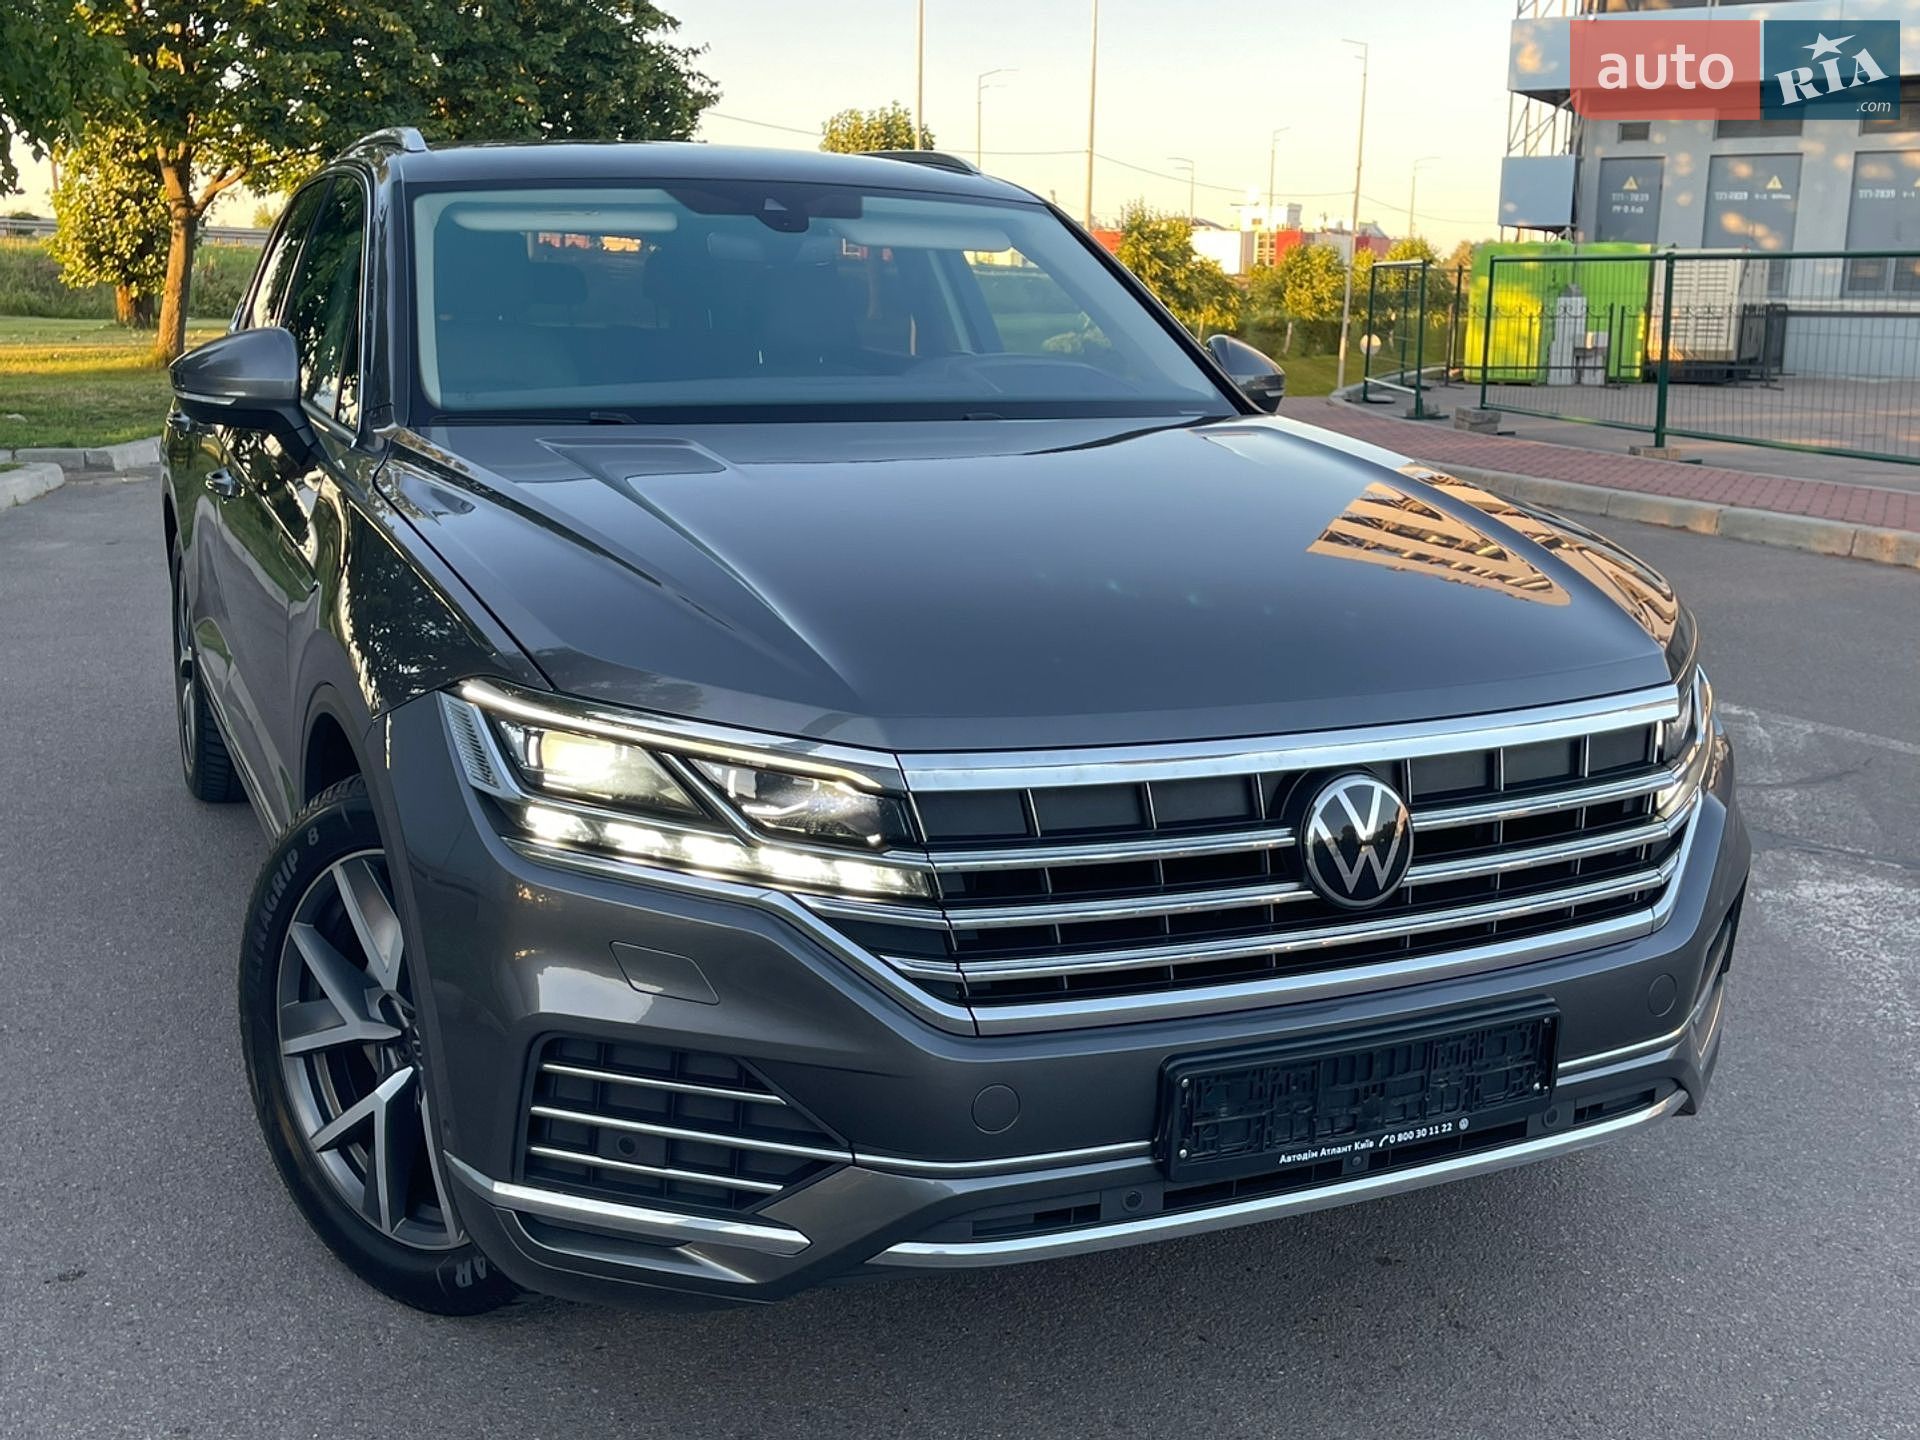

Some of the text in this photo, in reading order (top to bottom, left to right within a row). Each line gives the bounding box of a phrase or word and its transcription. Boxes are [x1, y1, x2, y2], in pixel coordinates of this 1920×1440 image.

[307, 826, 320, 846] 8
[1319, 1144, 1353, 1157] Атлант
[1354, 1139, 1375, 1151] Київ
[1397, 1130, 1415, 1142] 800
[1416, 1128, 1427, 1139] 30
[1429, 1125, 1440, 1136] 11
[1441, 1122, 1453, 1133] 22
